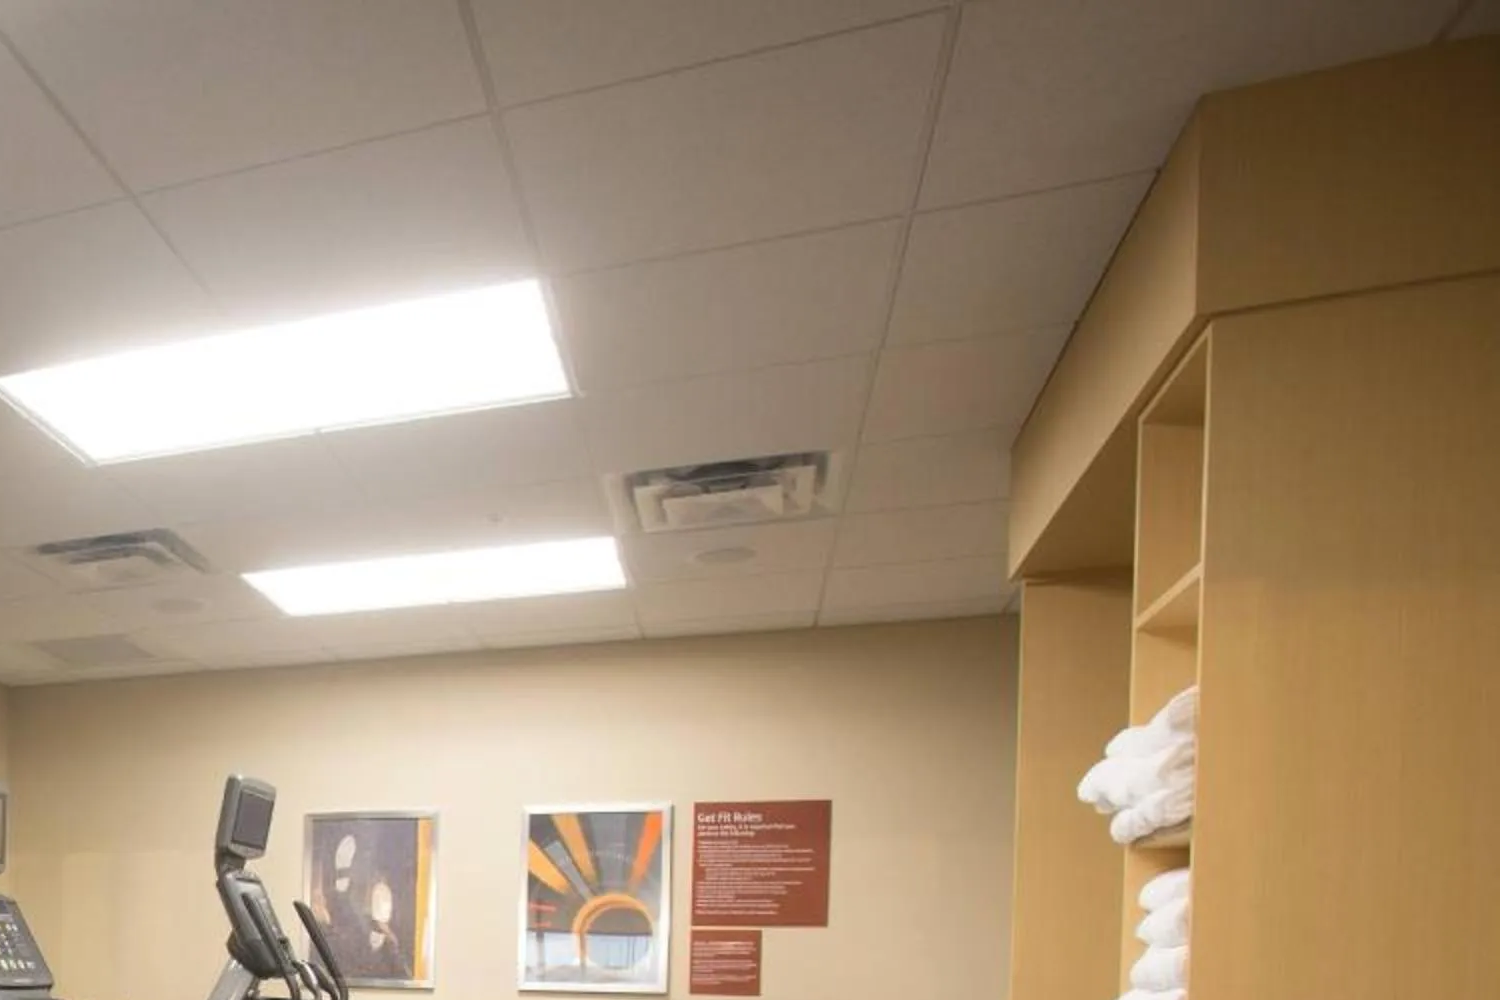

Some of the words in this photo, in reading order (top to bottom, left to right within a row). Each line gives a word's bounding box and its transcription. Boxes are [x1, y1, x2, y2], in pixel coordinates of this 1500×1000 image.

[697, 812, 715, 823] Get
[718, 811, 731, 823] Fit
[733, 811, 762, 823] Rules
